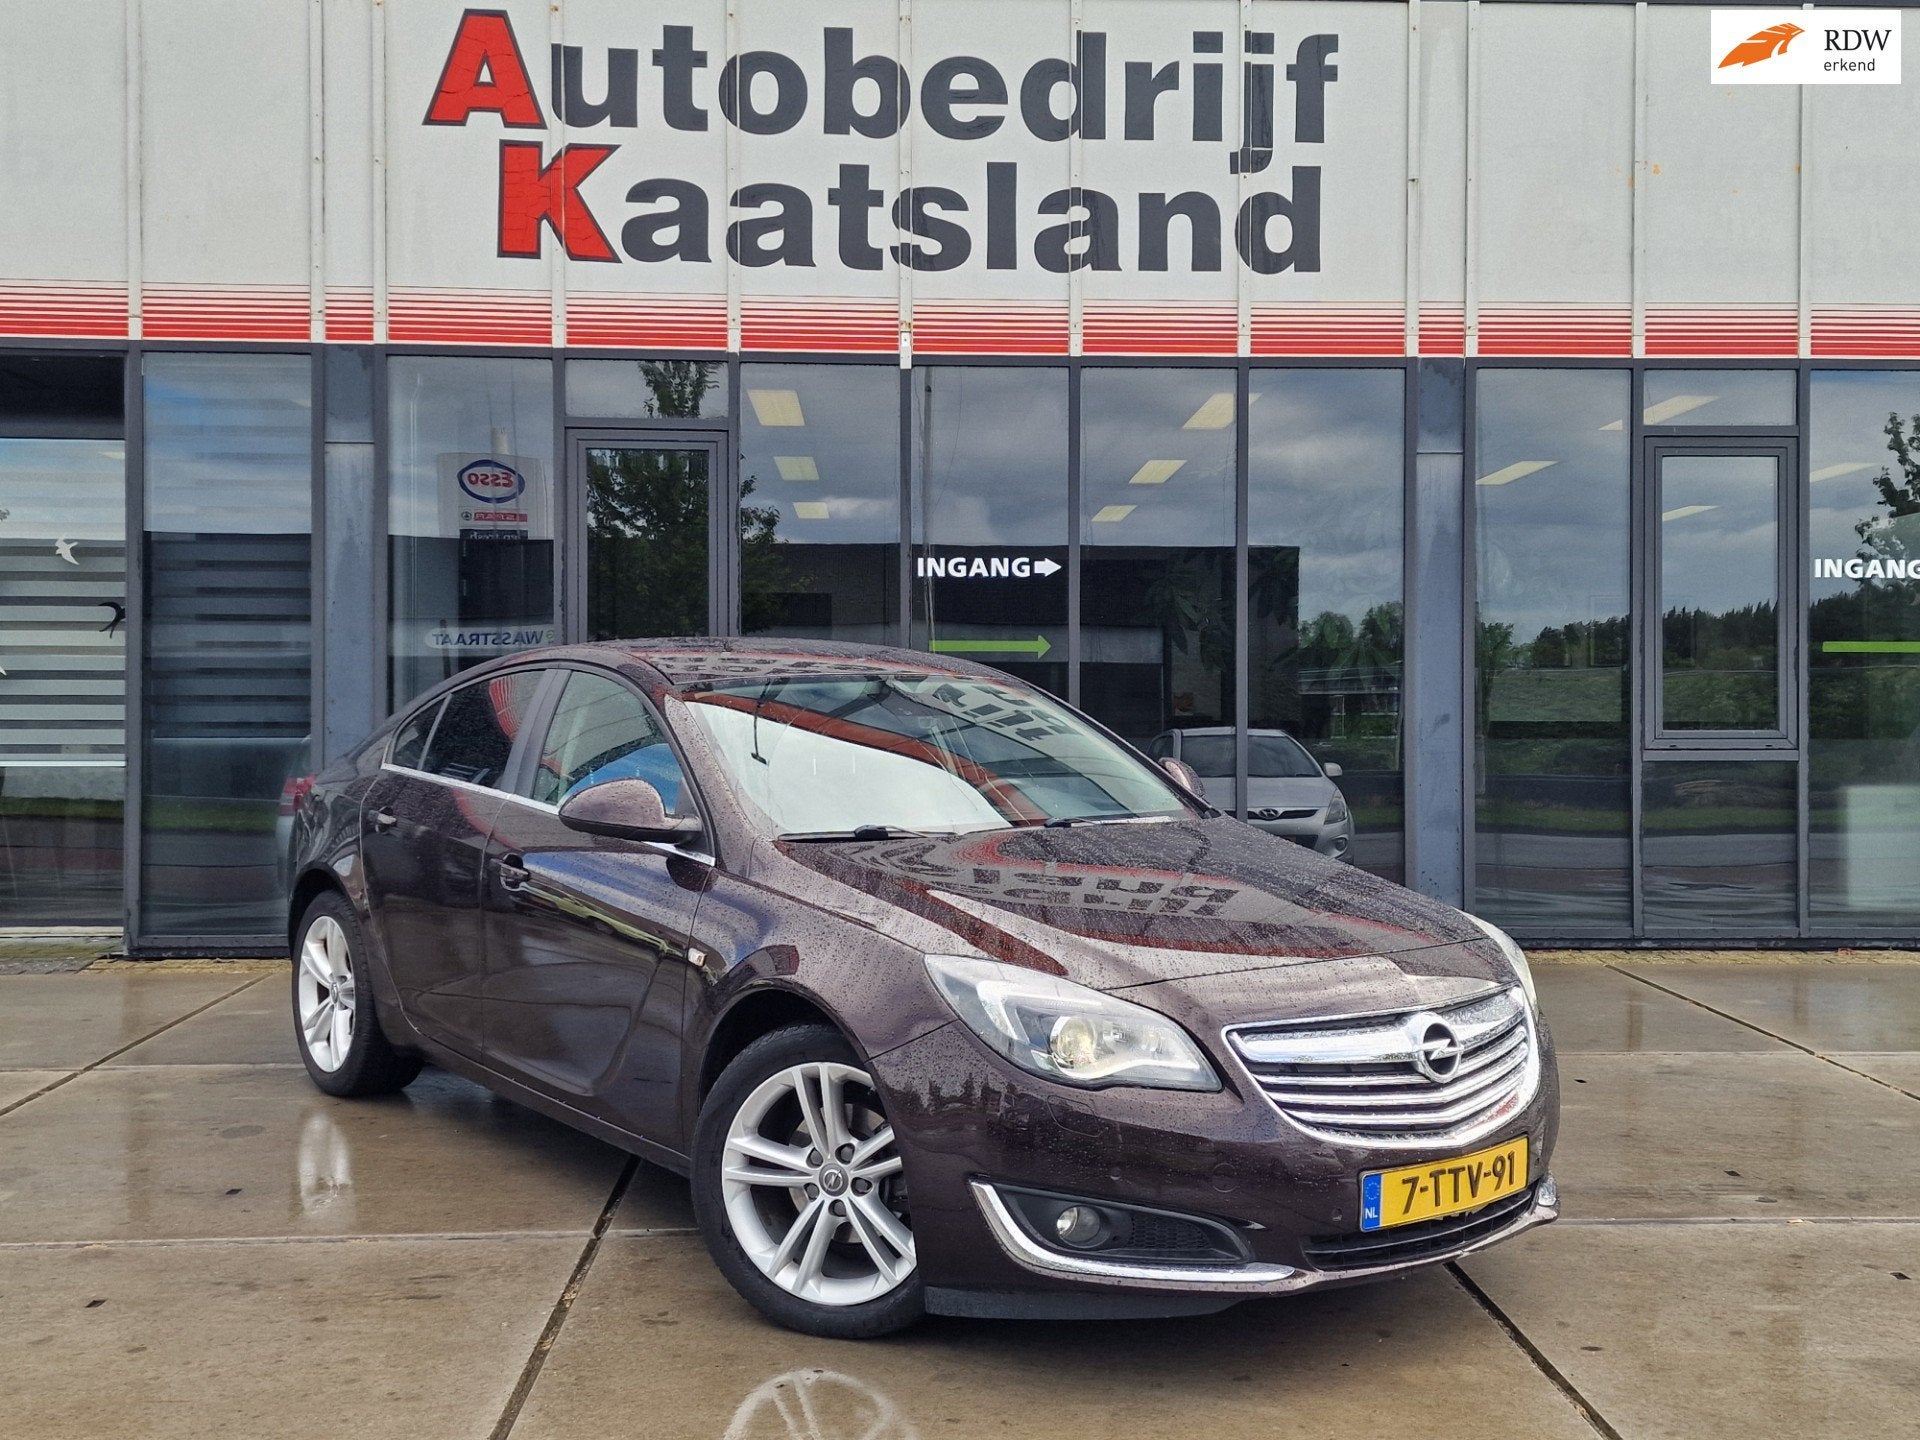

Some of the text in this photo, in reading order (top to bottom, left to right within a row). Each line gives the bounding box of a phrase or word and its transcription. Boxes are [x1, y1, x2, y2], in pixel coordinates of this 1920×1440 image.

[423, 8, 1339, 174] Autobedrijf
[497, 138, 1321, 275] Kaatsland
[917, 557, 1030, 578] INGANG
[1814, 558, 1920, 580] INGANG
[1365, 1151, 1515, 1219] NL 7-TTV-91
